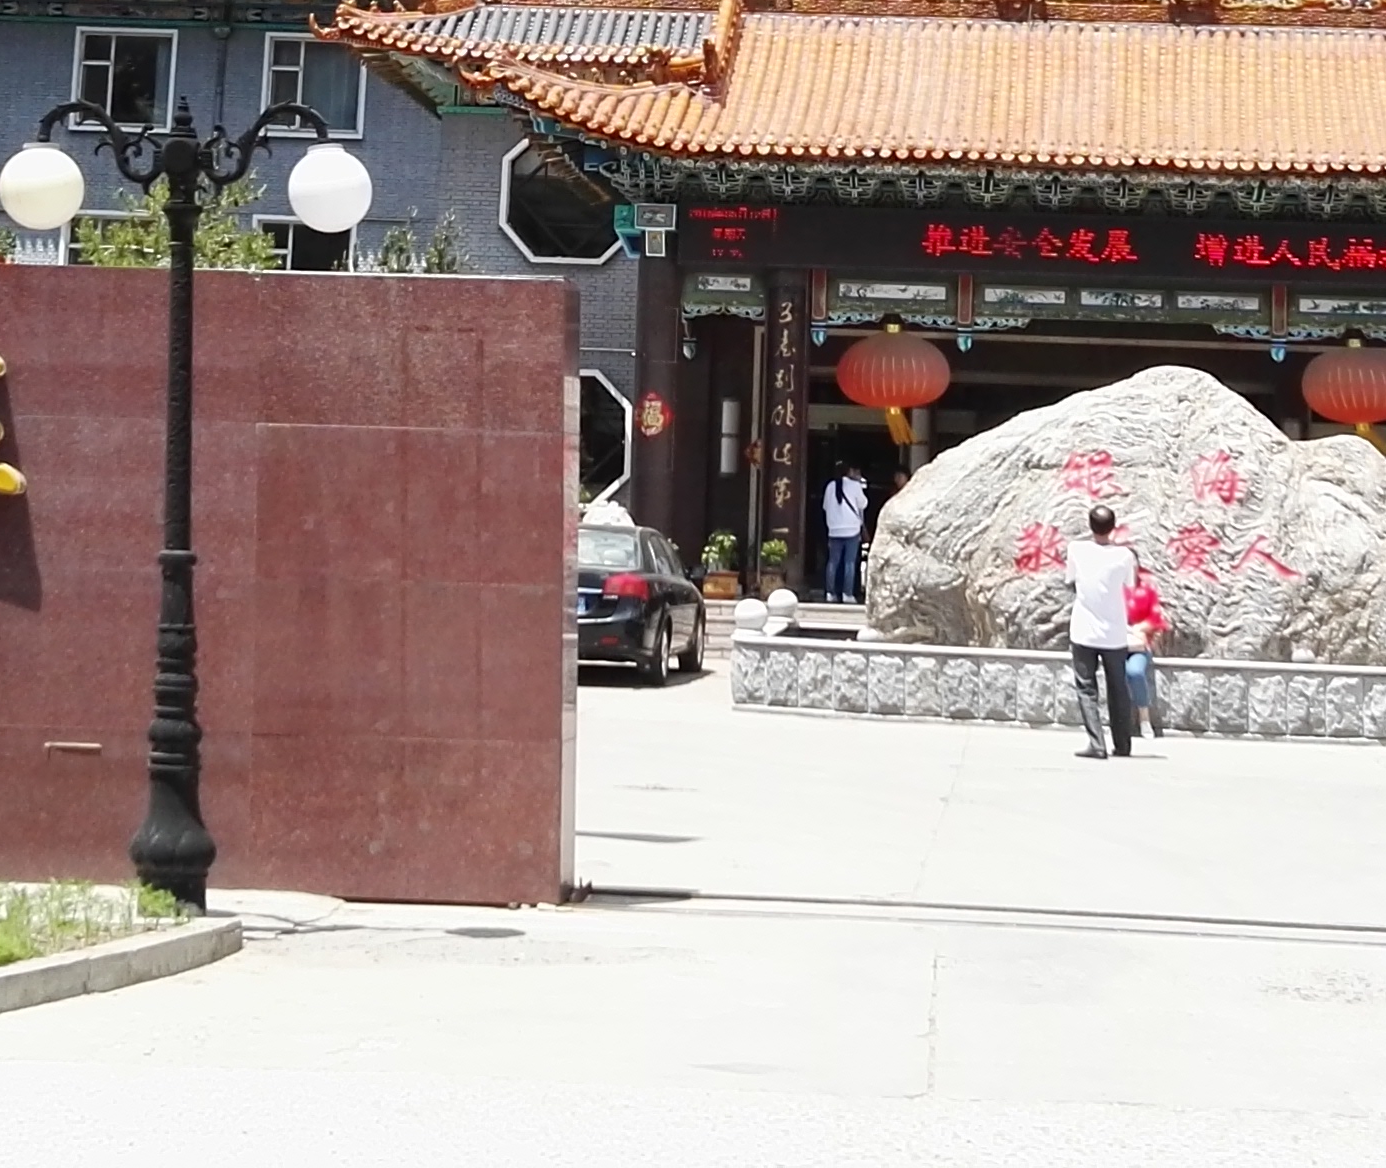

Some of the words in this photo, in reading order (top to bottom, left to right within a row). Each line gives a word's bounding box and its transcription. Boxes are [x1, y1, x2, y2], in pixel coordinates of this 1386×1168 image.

[921, 223, 1140, 263] 推进安全发展
